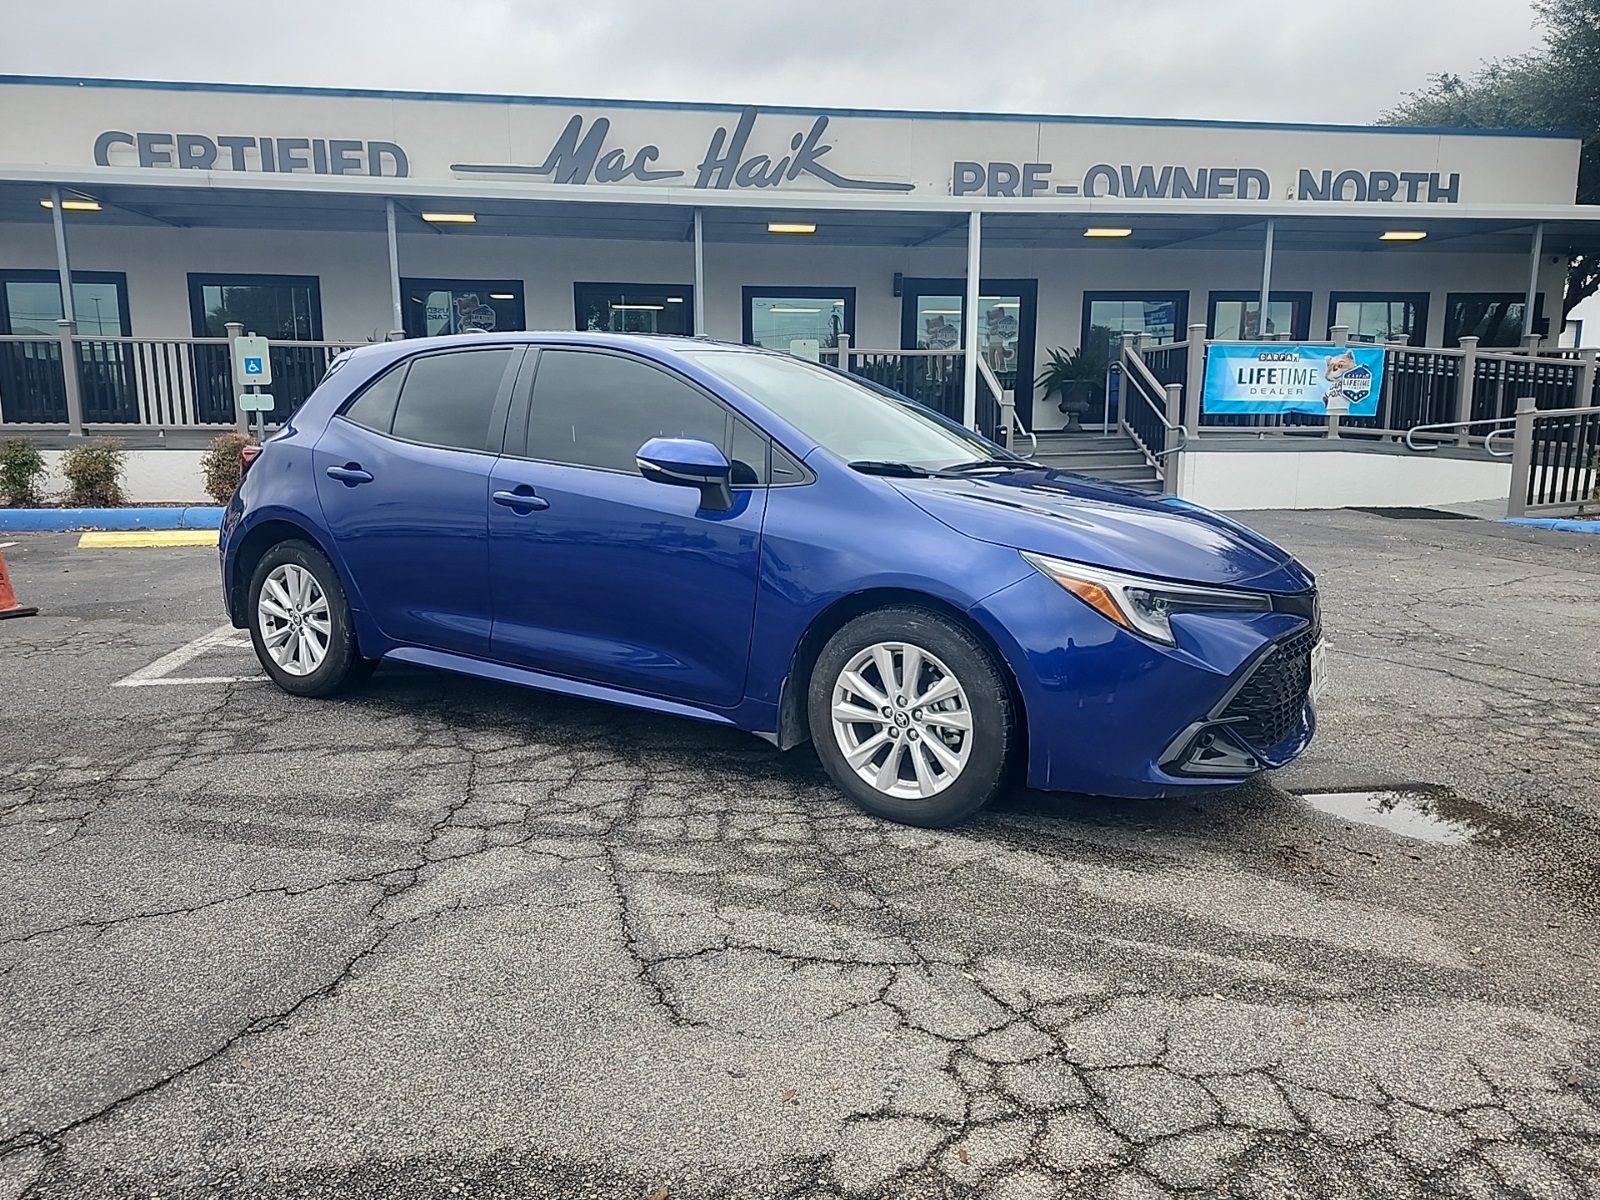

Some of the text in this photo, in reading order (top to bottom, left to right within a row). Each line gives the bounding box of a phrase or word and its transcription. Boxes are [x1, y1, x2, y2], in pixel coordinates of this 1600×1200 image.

[93, 130, 409, 178] CERTIFIED
[450, 105, 916, 190] Mac Haik
[953, 161, 1461, 203] PRE-OWNED NORTH
[1258, 352, 1300, 362] CARFAX
[1237, 367, 1319, 386] LIFETIME
[1250, 387, 1304, 395] DEALER
